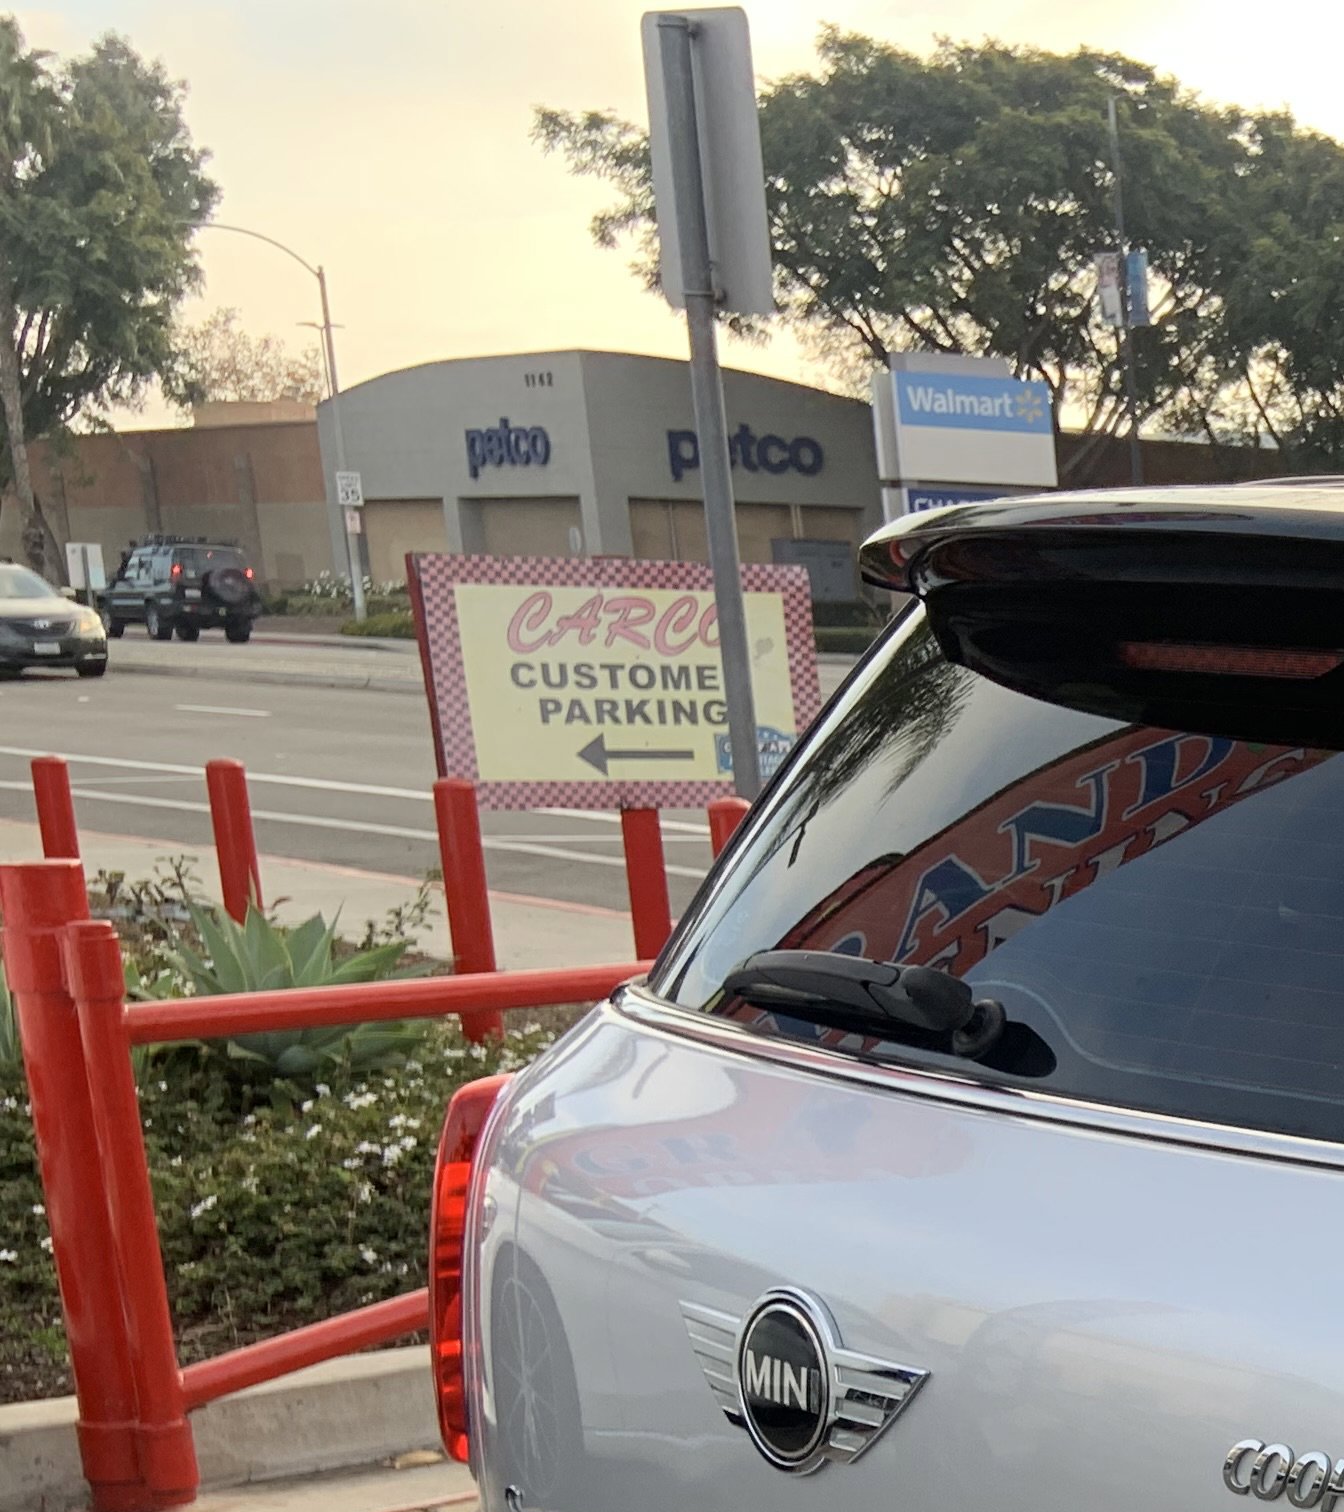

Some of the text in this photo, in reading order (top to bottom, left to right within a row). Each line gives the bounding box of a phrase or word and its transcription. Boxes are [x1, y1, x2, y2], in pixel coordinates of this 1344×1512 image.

[907, 385, 1014, 418] Walmart
[465, 416, 550, 479] petco
[667, 422, 824, 482] ptco
[510, 662, 721, 690] CUSTOME
[539, 697, 730, 726] PARKING
[746, 1349, 820, 1415] MINI
